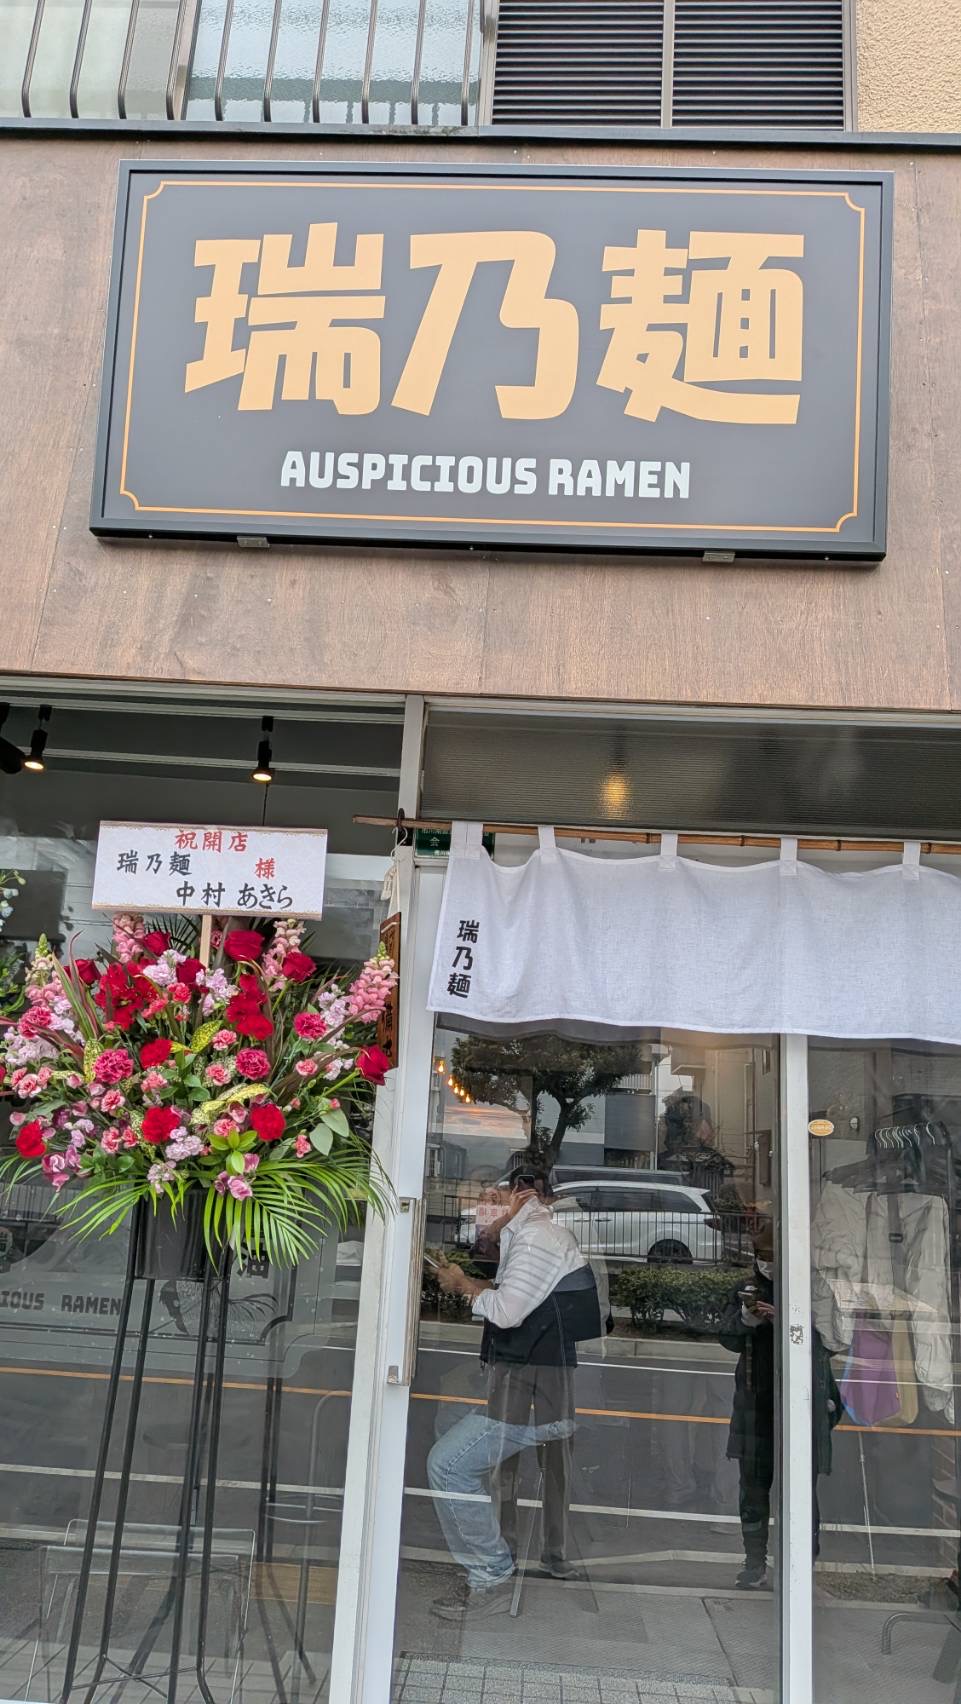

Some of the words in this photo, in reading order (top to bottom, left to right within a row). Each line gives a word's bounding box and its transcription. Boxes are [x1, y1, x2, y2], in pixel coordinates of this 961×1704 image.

[184, 222, 804, 424] 瑞乃麺
[280, 450, 538, 496] AUSPICIOUS
[547, 458, 691, 500] RAMEN
[175, 829, 249, 853] 祝開店
[116, 849, 192, 876] 瑞乃麺
[255, 857, 276, 880] 様
[176, 880, 226, 907] 中村
[237, 882, 293, 910] あきら
[446, 919, 480, 998] 瑞乃麺
[61, 1294, 122, 1316] RAMEN
